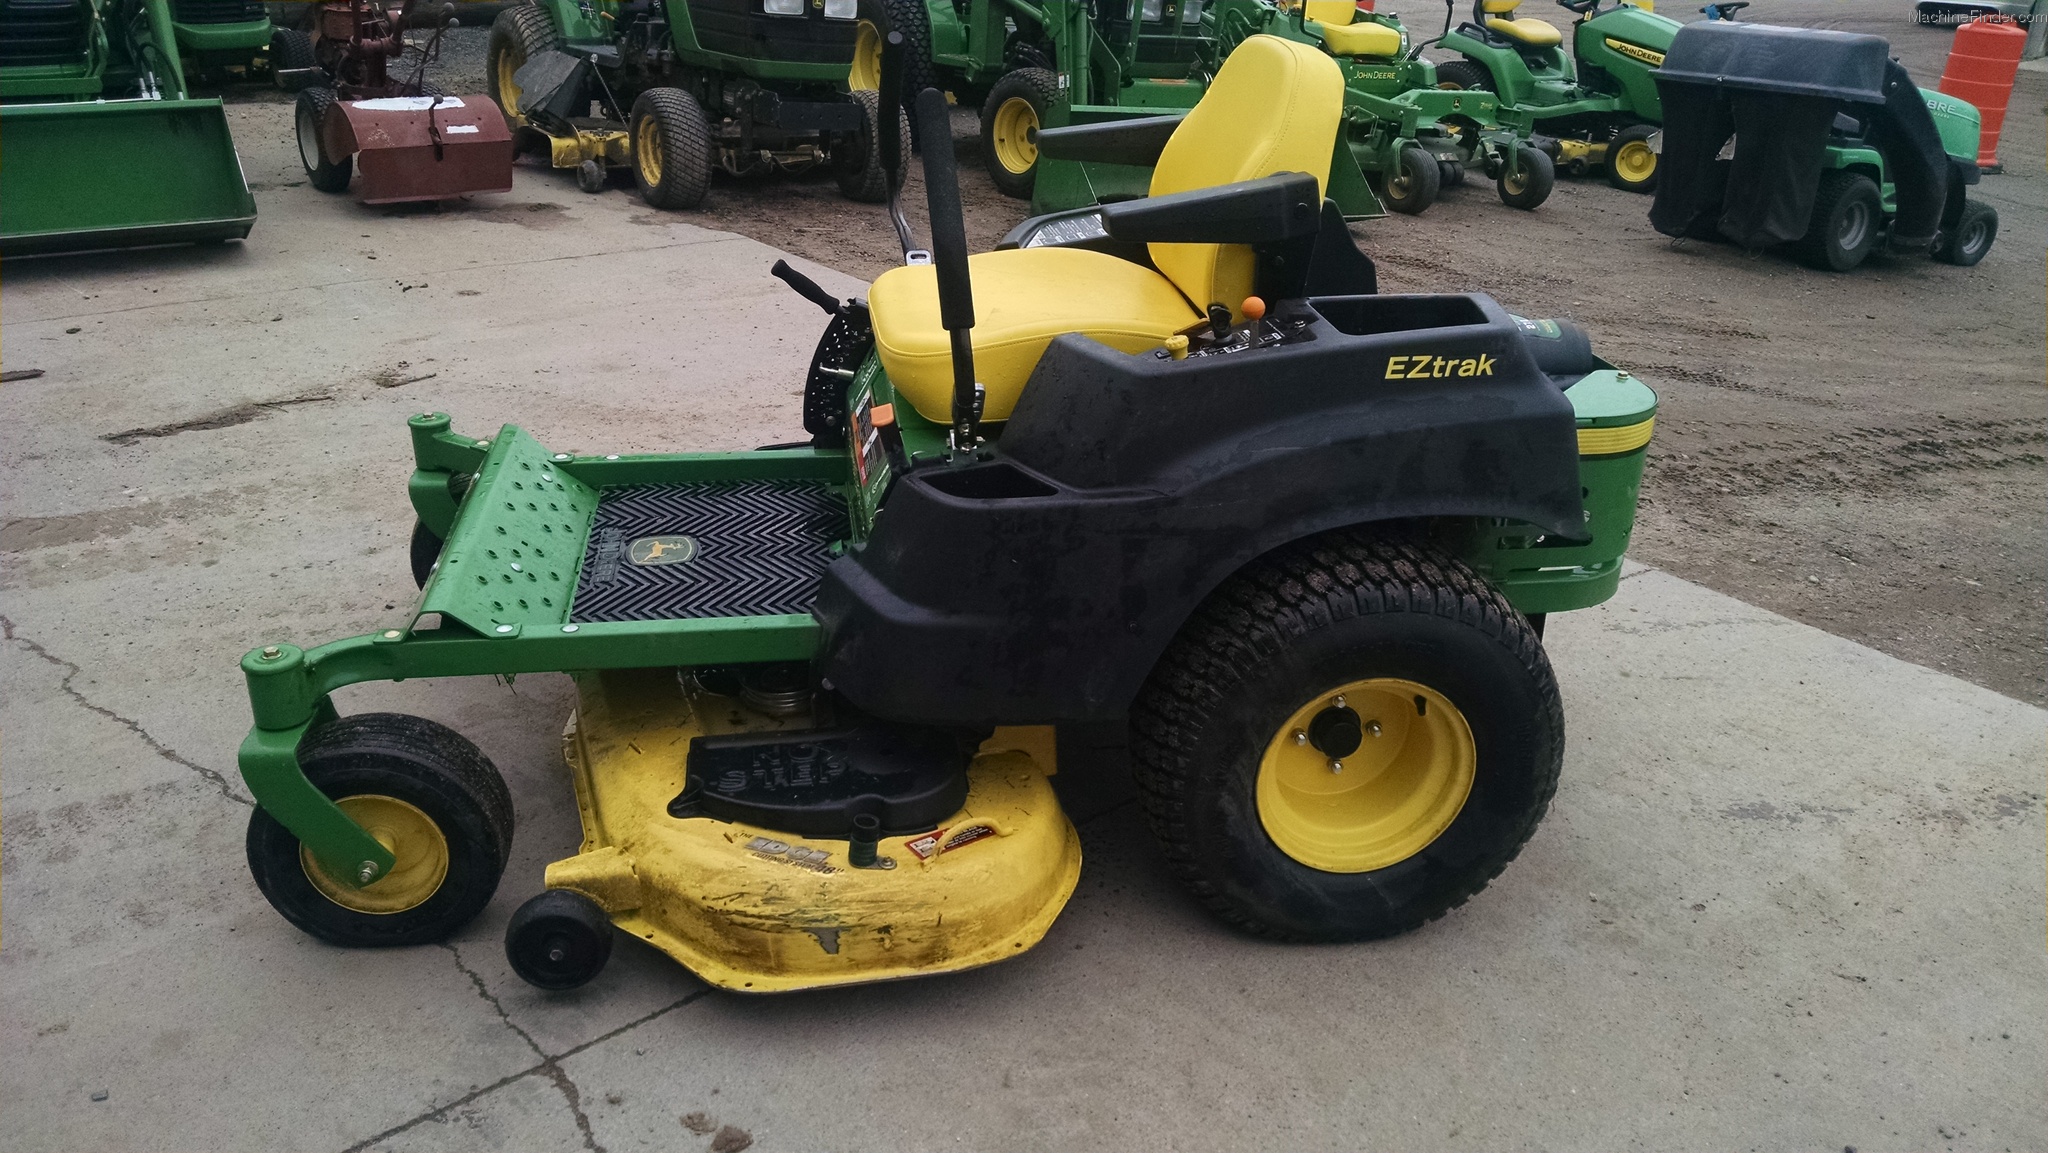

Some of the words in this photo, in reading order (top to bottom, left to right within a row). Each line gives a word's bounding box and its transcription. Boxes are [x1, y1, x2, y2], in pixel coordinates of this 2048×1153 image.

[1617, 44, 1637, 55] JOHN
[1637, 50, 1662, 63] DEERE
[1354, 71, 1373, 79] JOHN
[1373, 71, 1396, 79] DEERE
[1927, 99, 1957, 114] BRE
[1385, 353, 1497, 379] EZtrak
